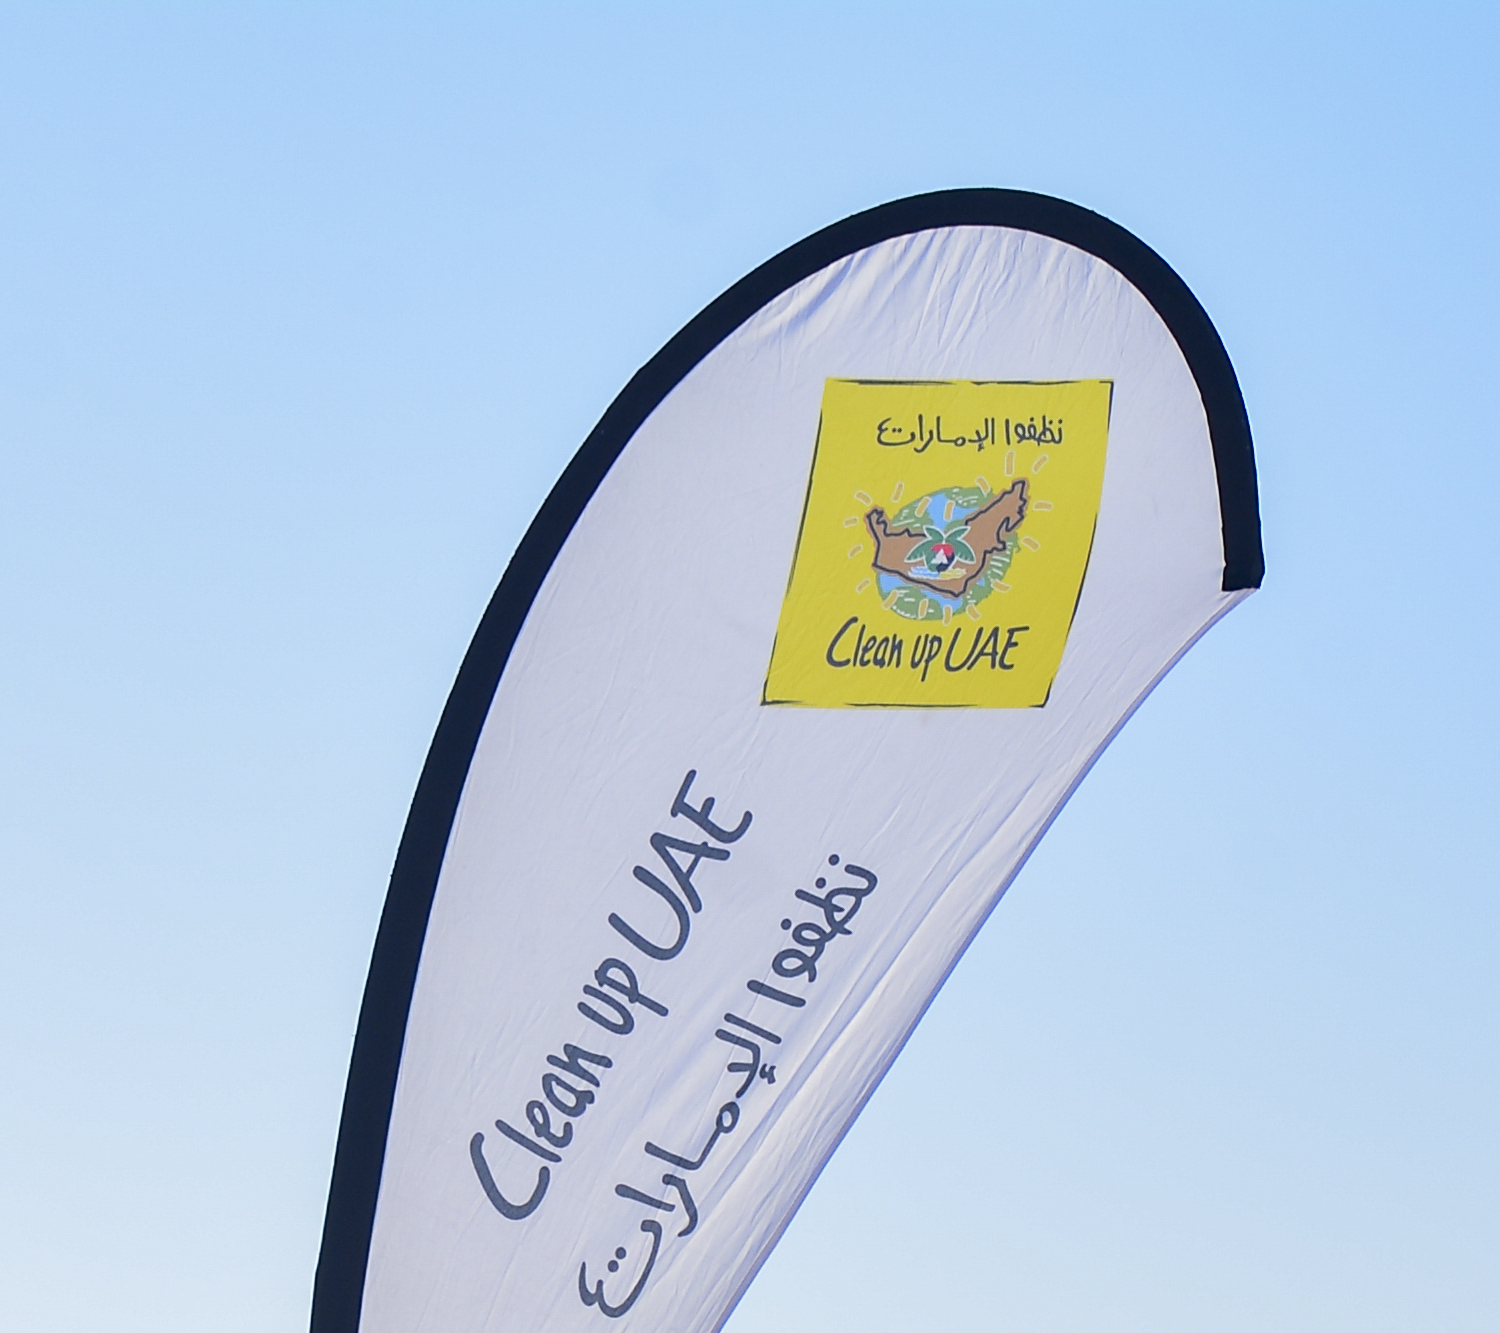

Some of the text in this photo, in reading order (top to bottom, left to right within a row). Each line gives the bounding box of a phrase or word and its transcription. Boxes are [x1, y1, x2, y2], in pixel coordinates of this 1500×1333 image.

[1004, 414, 1064, 447] نظفوا
[825, 616, 1030, 683] Clean up UAE
[746, 853, 879, 1008] نظفوا
[468, 768, 754, 1222] Clean up UAE
